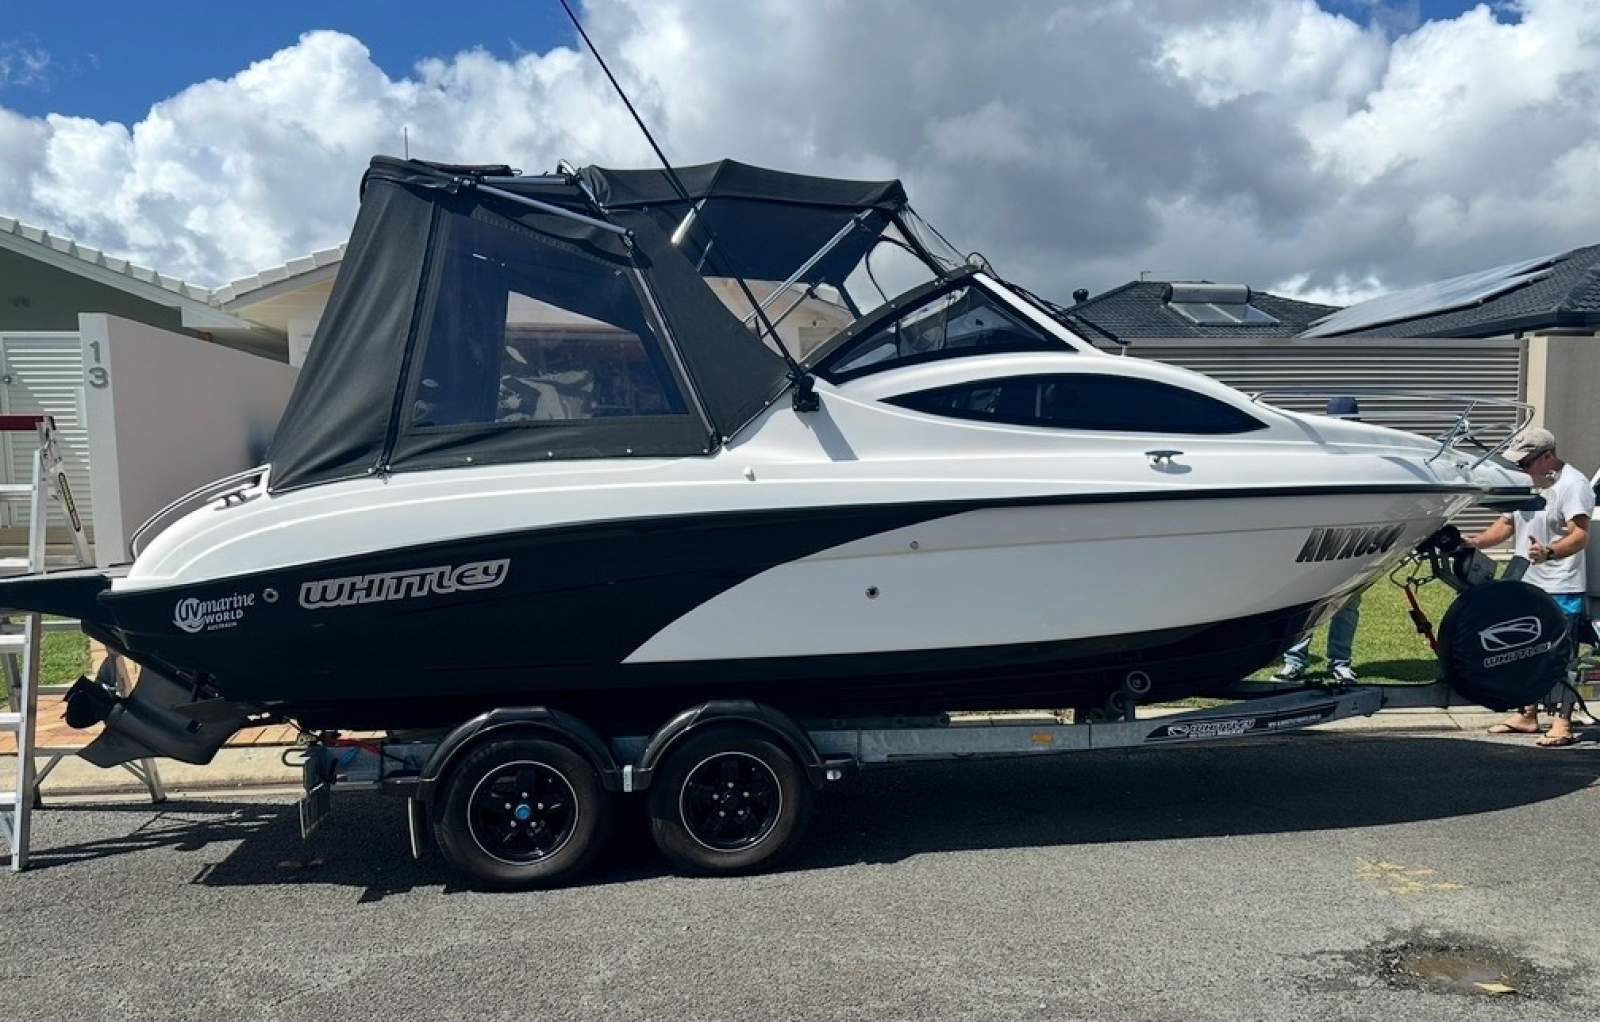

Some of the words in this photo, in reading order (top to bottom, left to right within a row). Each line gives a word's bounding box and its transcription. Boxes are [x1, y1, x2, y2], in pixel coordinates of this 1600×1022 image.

[88, 340, 110, 389] 13
[299, 558, 511, 609] WHITTLEY
[200, 592, 255, 613] marine
[205, 609, 244, 624] WORLD
